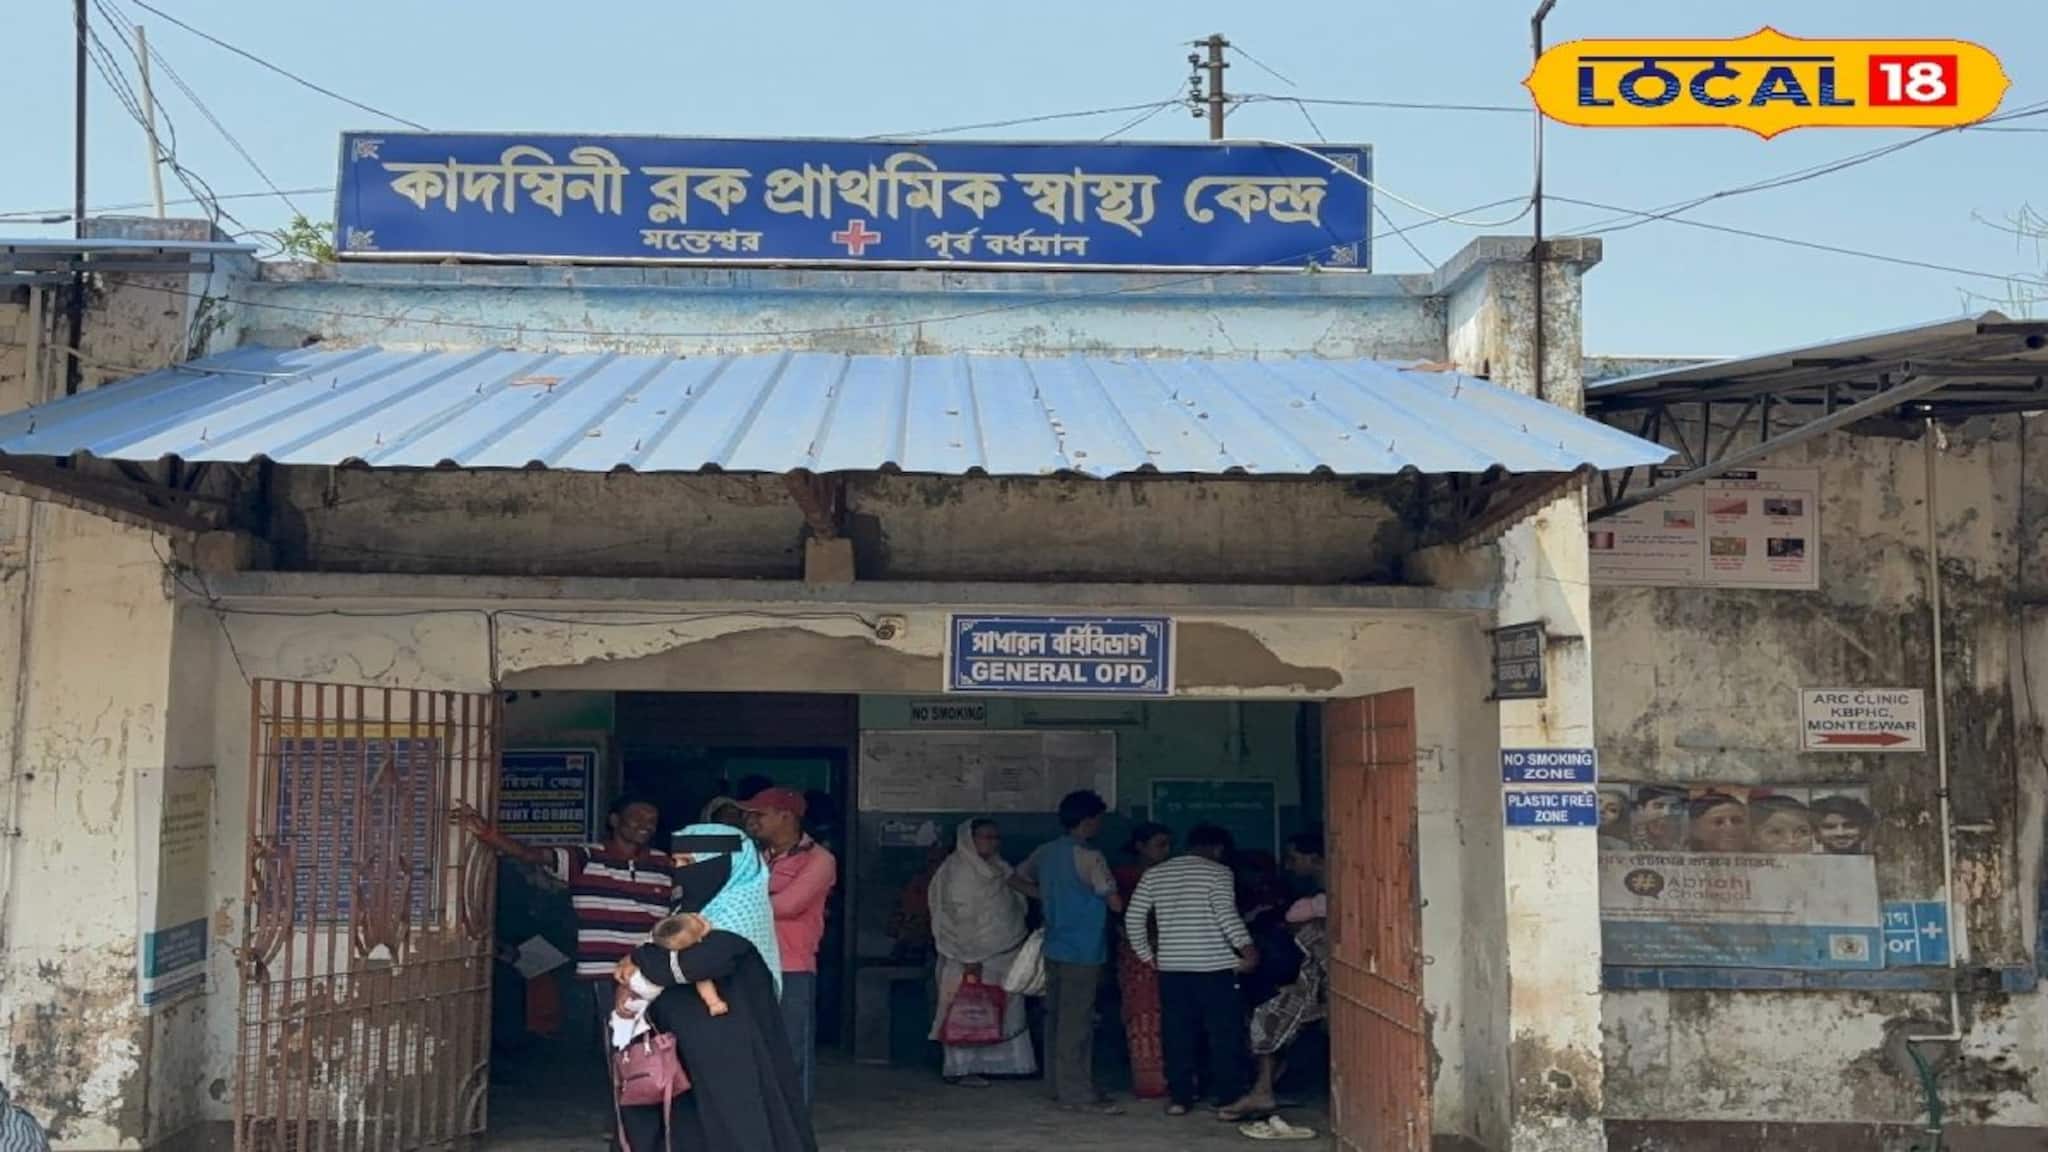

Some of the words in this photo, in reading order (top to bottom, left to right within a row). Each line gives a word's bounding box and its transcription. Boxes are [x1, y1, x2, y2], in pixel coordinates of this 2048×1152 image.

[382, 145, 631, 217] কাদম্বিনী
[640, 166, 752, 224] ব্লক
[764, 152, 1006, 220] প্রাথমিক
[1013, 167, 1162, 238] স্বাস্থ্য
[1183, 175, 1329, 228] কেন্দ্র
[926, 227, 979, 258] পূর্ব
[986, 228, 1091, 256] বর্ধমান
[971, 661, 1088, 683] GENERAL
[1095, 663, 1147, 684] OPD
[1813, 693, 1849, 704] ARC
[1854, 694, 1910, 705] CLINIC
[912, 706, 929, 721] NO
[931, 706, 985, 721] SMOKING
[1807, 719, 1917, 731] MONTESWAR
[1504, 753, 1524, 766] NO
[1527, 753, 1593, 766] SMOKING
[1523, 768, 1577, 779] ZONE
[1508, 794, 1560, 807] PLASTIC
[1561, 794, 1594, 807] FREE
[1534, 810, 1569, 823] ZONE
